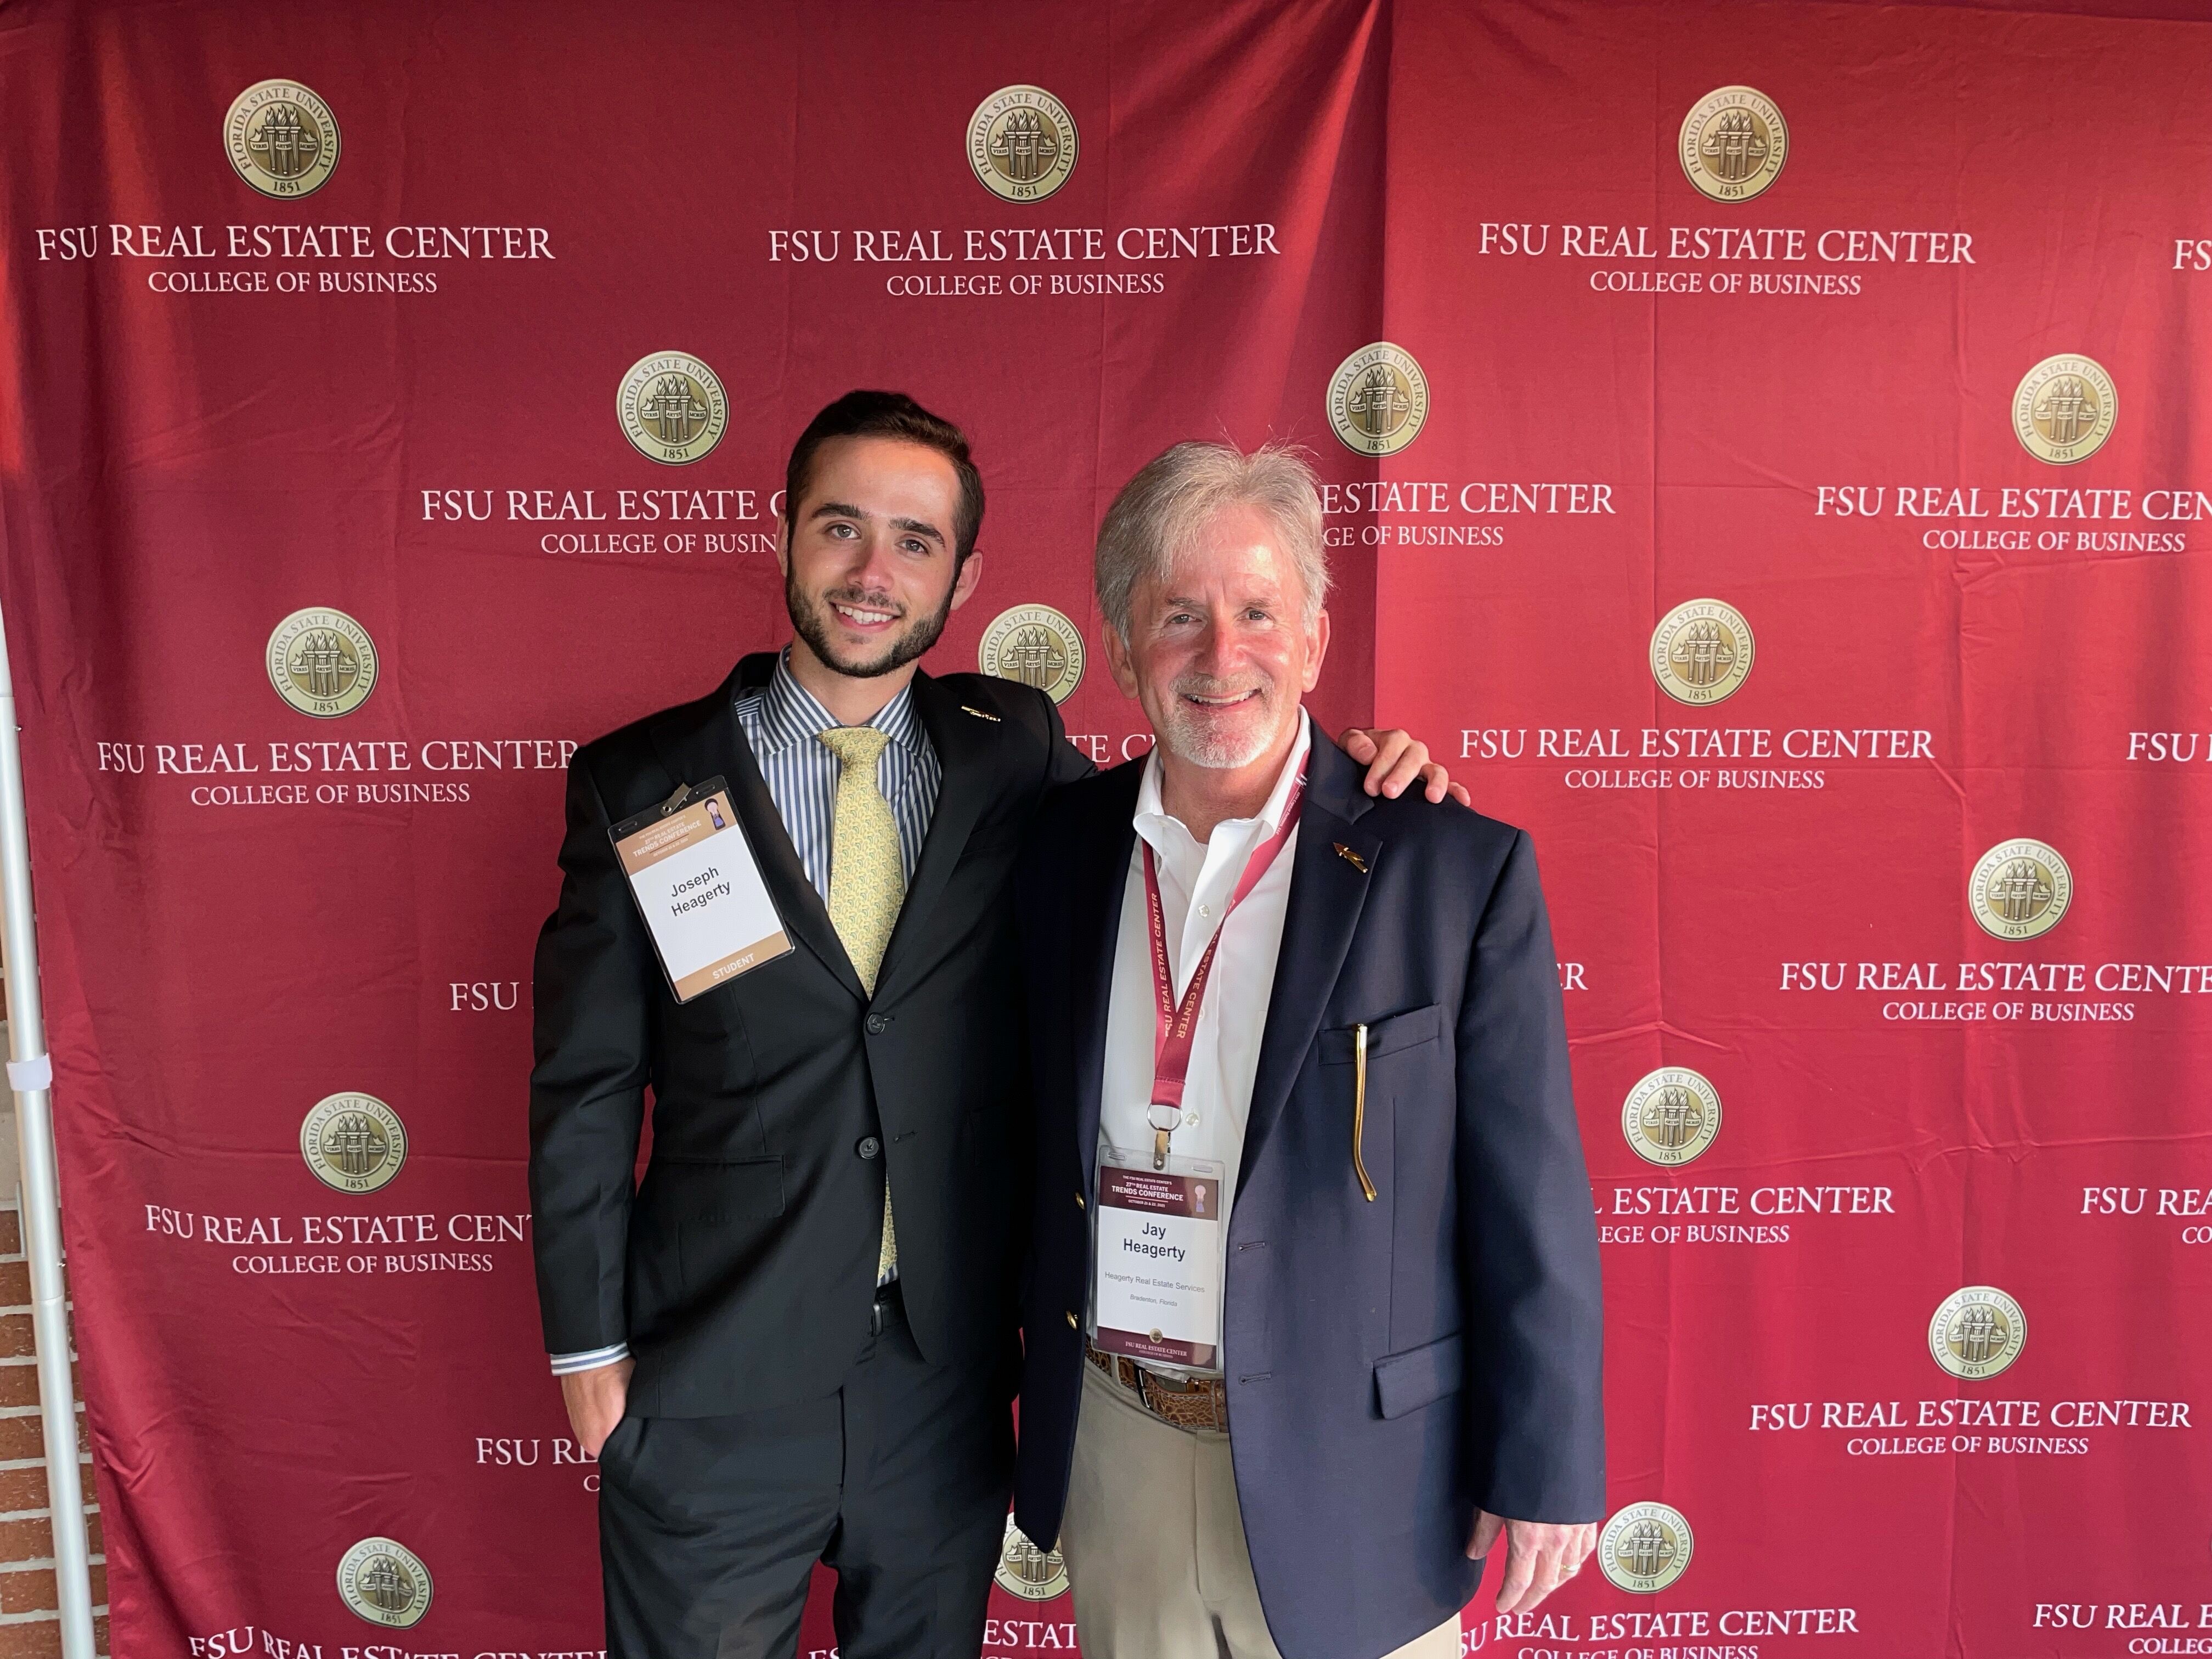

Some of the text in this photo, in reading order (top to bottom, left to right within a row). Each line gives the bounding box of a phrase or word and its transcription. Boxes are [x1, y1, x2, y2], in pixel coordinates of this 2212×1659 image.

[233, 88, 334, 172] FLORIDA STATE UNIVERSITY
[273, 182, 301, 193] 1851
[36, 224, 556, 260] FSU REAL ESTATE CENTER
[769, 224, 1280, 261] FSU REAL ESTATE CENTER
[1479, 223, 1976, 263] FSU REAL ESTATE CENTER
[148, 272, 437, 292] COLLEGE OF BUSINESS
[887, 273, 1164, 295] COLLEGE OF BUSINESS
[1590, 271, 1861, 295] COLLEGE OF BUSINESS
[625, 359, 723, 439] FLORIDA STATE UNIVERSITY
[663, 448, 690, 459] 1851
[421, 490, 494, 520] FSU
[506, 490, 606, 520] REAL
[617, 489, 759, 520] ESTATE
[1321, 481, 1616, 514] ESTATE CENTER
[1815, 487, 1886, 516] FSU
[1895, 487, 1989, 517] REAL
[1999, 488, 2131, 519] ESTATE
[541, 534, 657, 553] COLLEGE
[664, 534, 696, 553] OF
[1362, 526, 1391, 545] OF
[1398, 526, 1503, 545] BUSINESS
[1923, 530, 2185, 552] COLLEGE OF BUSINESS
[1657, 606, 1748, 681] FLORIDA STATE UNIVERSITY
[1688, 690, 1712, 700] 1851
[97, 742, 145, 773] FSU
[155, 743, 258, 774] REAL
[268, 742, 411, 772] ESTATE
[1460, 729, 1935, 758] FSU REAL ESTATE CENTER
[2126, 732, 2199, 761] FSU
[1565, 770, 1824, 788] COLLEGE OF BUSINESS
[191, 783, 470, 805] COLLEGE OF BUSINESS
[633, 841, 658, 857] TRENDS
[659, 820, 702, 844] CONFERENCE
[672, 867, 719, 897] Joseph
[671, 882, 730, 917] Heagerty
[1151, 893, 1161, 938] CENTER
[712, 953, 755, 979] STUDENT
[1155, 939, 1167, 981] ESTATE
[1780, 963, 1847, 990] FSU
[1856, 963, 1946, 990] REAL
[1956, 962, 2085, 991] ESTATE
[449, 982, 519, 1011] FSU
[1161, 984, 1172, 1013] REAL
[1176, 992, 1197, 1039] CENTER
[1883, 1002, 2134, 1021] COLLEGE OF BUSINESS
[309, 1099, 401, 1170] FLORIDA STATE UNIVERSITY
[345, 1179, 369, 1189] 1851
[1111, 1185, 1183, 1201] TRENDS CONFERENCE
[1612, 1187, 1739, 1214] ESTATE
[1751, 1186, 1895, 1215] CENTER
[2081, 1187, 2148, 1214] FSU
[145, 1205, 193, 1238] FSU
[202, 1216, 292, 1244] REAL
[302, 1215, 438, 1243] ESTATE
[1142, 1222, 1166, 1240] Jay
[1651, 1226, 1681, 1243] OF
[1686, 1225, 1789, 1243] BUSINESS
[233, 1253, 493, 1273] COLLEGE OF BUSINESS
[1124, 1238, 1186, 1262] Heagerty
[1105, 1271, 1205, 1293] Heagerty Real Estate Services
[1749, 1399, 2192, 1430] FSU REAL ESTATE CENTER
[476, 1438, 540, 1465] FSU
[1847, 1436, 2089, 1455] COLLEGE OF BUSINESS
[1494, 1612, 1580, 1641] REAL
[1589, 1612, 1709, 1641] ESTATE
[1719, 1609, 1859, 1635] CENTER
[2033, 1604, 2098, 1628] FSU
[2105, 1604, 2189, 1628] REAL
[189, 1626, 254, 1659] FSU
[1661, 1646, 1758, 1659] BUSINESS
